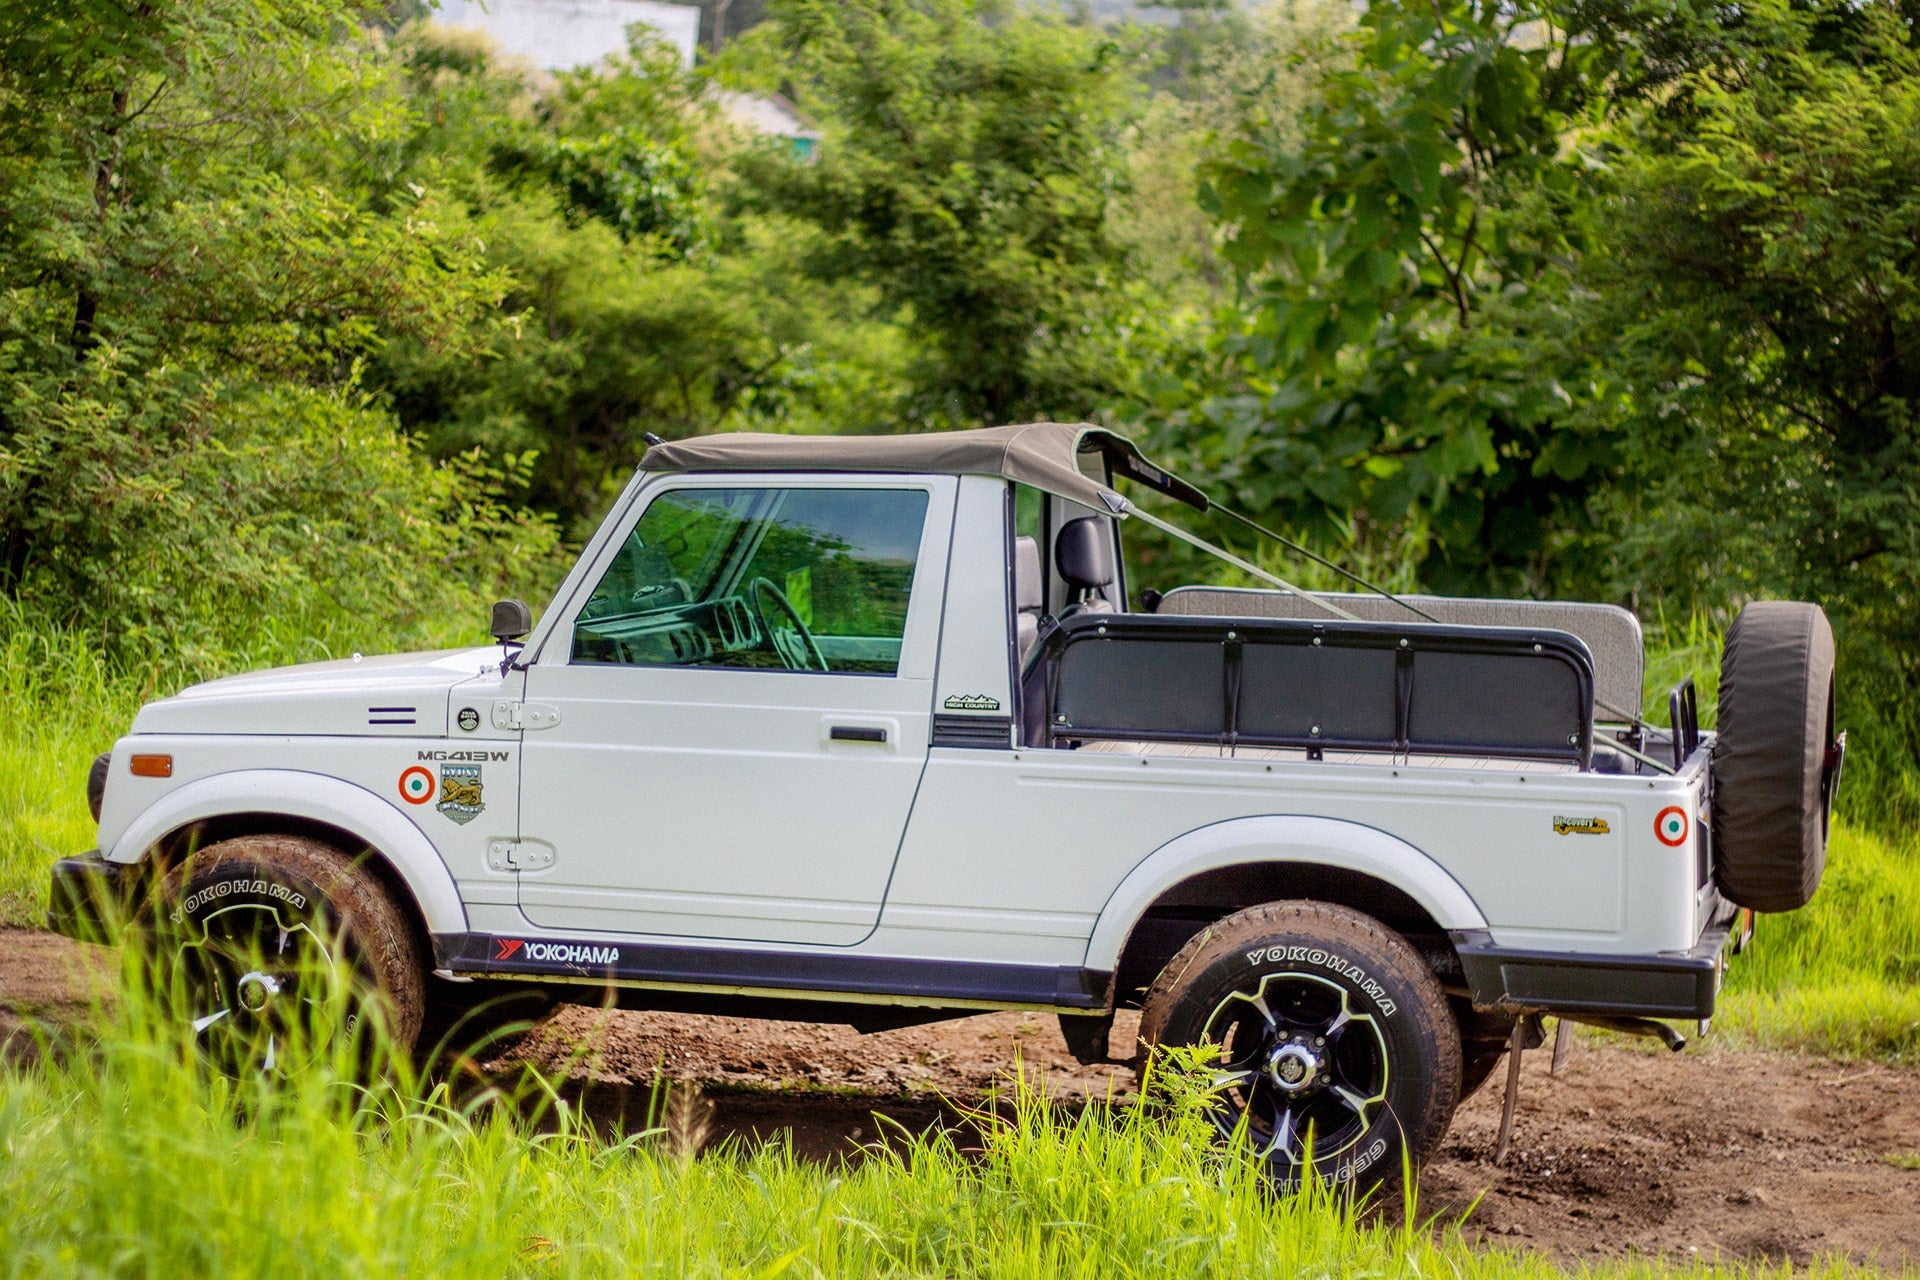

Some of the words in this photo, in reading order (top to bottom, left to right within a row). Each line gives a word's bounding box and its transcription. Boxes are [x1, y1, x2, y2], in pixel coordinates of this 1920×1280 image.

[417, 750, 510, 762] MG413W
[169, 879, 307, 925] YOKOHAMA
[524, 942, 620, 964] YOKOHAMA
[1246, 945, 1398, 1018] YOKOHAMA
